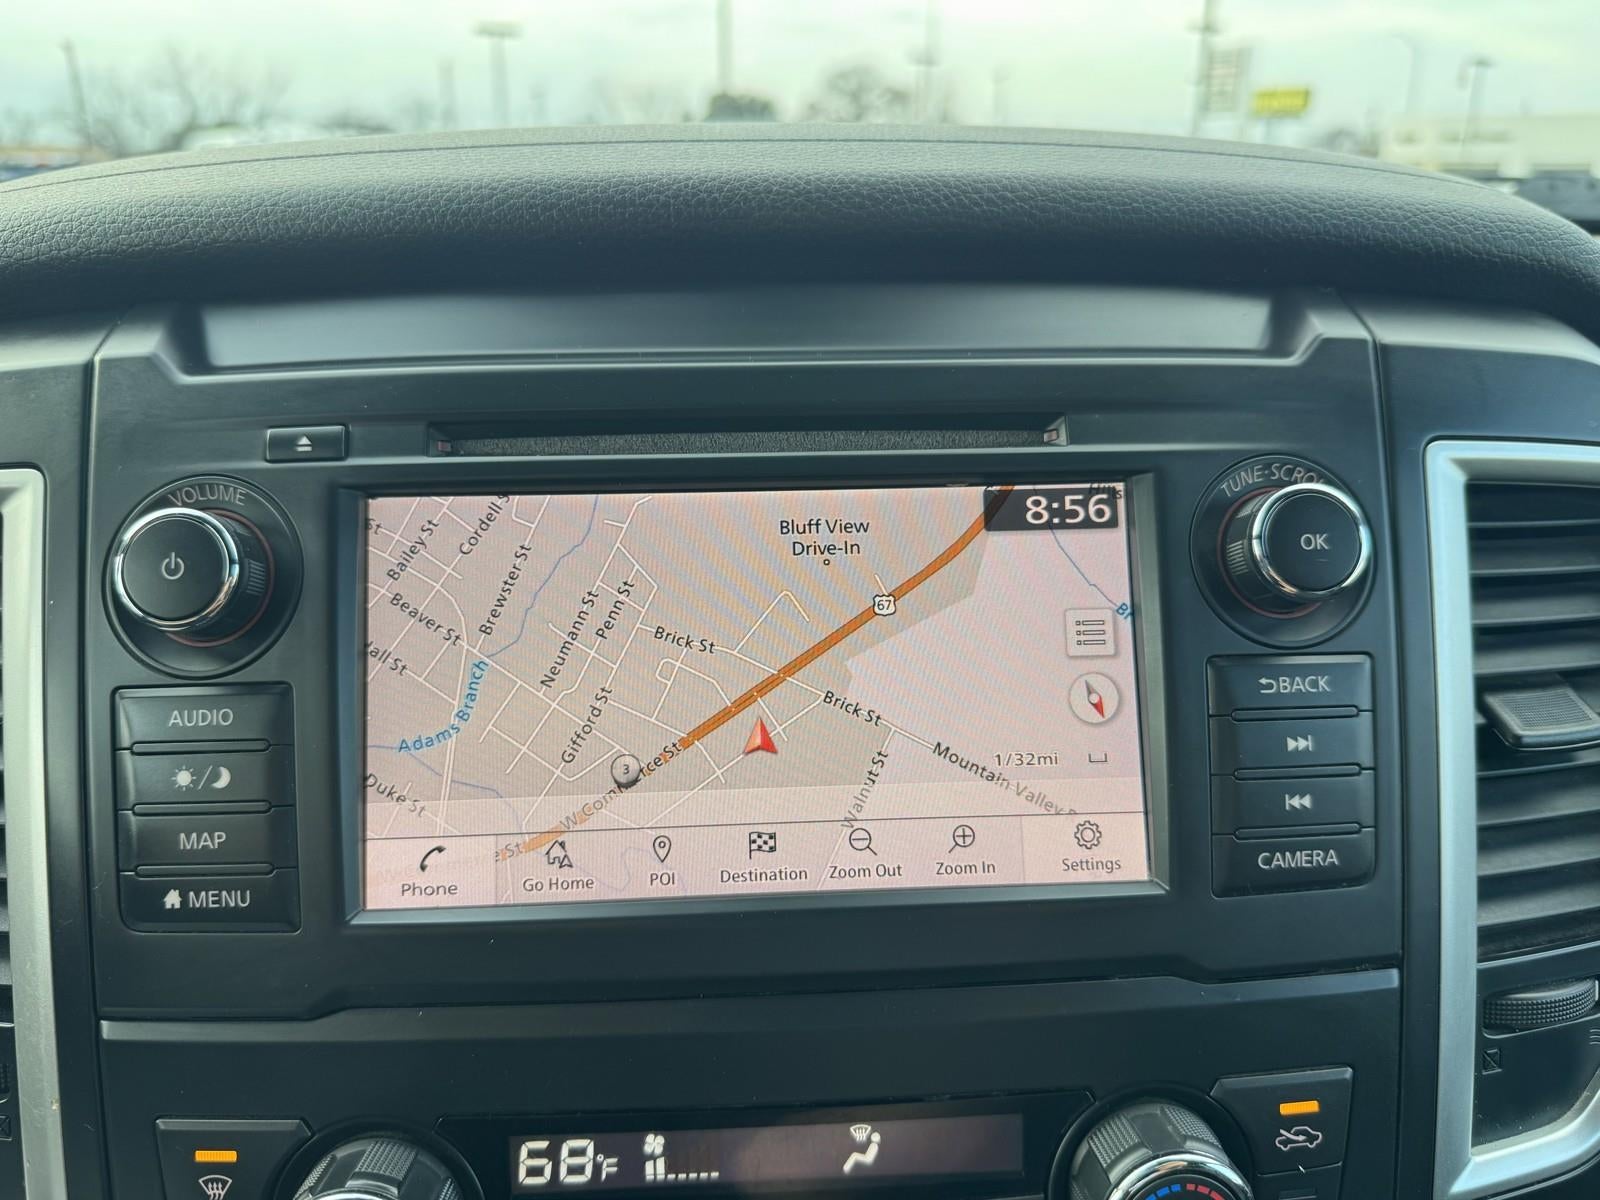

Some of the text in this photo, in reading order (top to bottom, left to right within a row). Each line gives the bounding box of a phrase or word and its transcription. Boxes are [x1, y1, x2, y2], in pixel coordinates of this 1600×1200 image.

[168, 484, 248, 506] VOLUME
[1026, 494, 1112, 524] 8:56
[459, 501, 503, 556] Cordell
[780, 518, 870, 535] Bluff View
[386, 519, 440, 581] Bailey St
[792, 540, 861, 556] Drive-In
[1300, 533, 1330, 550] OK
[479, 543, 532, 636] Brewster St
[595, 580, 635, 640] Penn St
[877, 599, 892, 611] 67
[390, 592, 462, 646] Beaver St
[540, 590, 599, 688] Neumann St
[654, 626, 716, 654] Brick St
[389, 658, 408, 676] St
[1278, 675, 1331, 693] BACK
[398, 660, 489, 752] Adams Branch
[823, 690, 882, 727] Brick St
[168, 708, 234, 727] AUDIO
[561, 686, 613, 764] Gifford St
[932, 742, 1011, 791] Mountain
[994, 752, 1059, 767] 1/32mi
[623, 764, 630, 775] 3
[364, 773, 426, 818] Duke St
[560, 742, 682, 830] W Comrce St
[840, 749, 889, 829] Walnut St
[179, 831, 227, 850] MAP
[935, 860, 996, 876] Zoom In
[1062, 857, 1122, 874] Settings
[1257, 849, 1340, 869] CAMERA
[649, 872, 675, 886] POI
[720, 867, 808, 883] Destination
[829, 863, 903, 880] Zoom Out
[401, 882, 458, 897] Phone
[522, 876, 595, 892] Go Home
[188, 890, 250, 908] MENU
